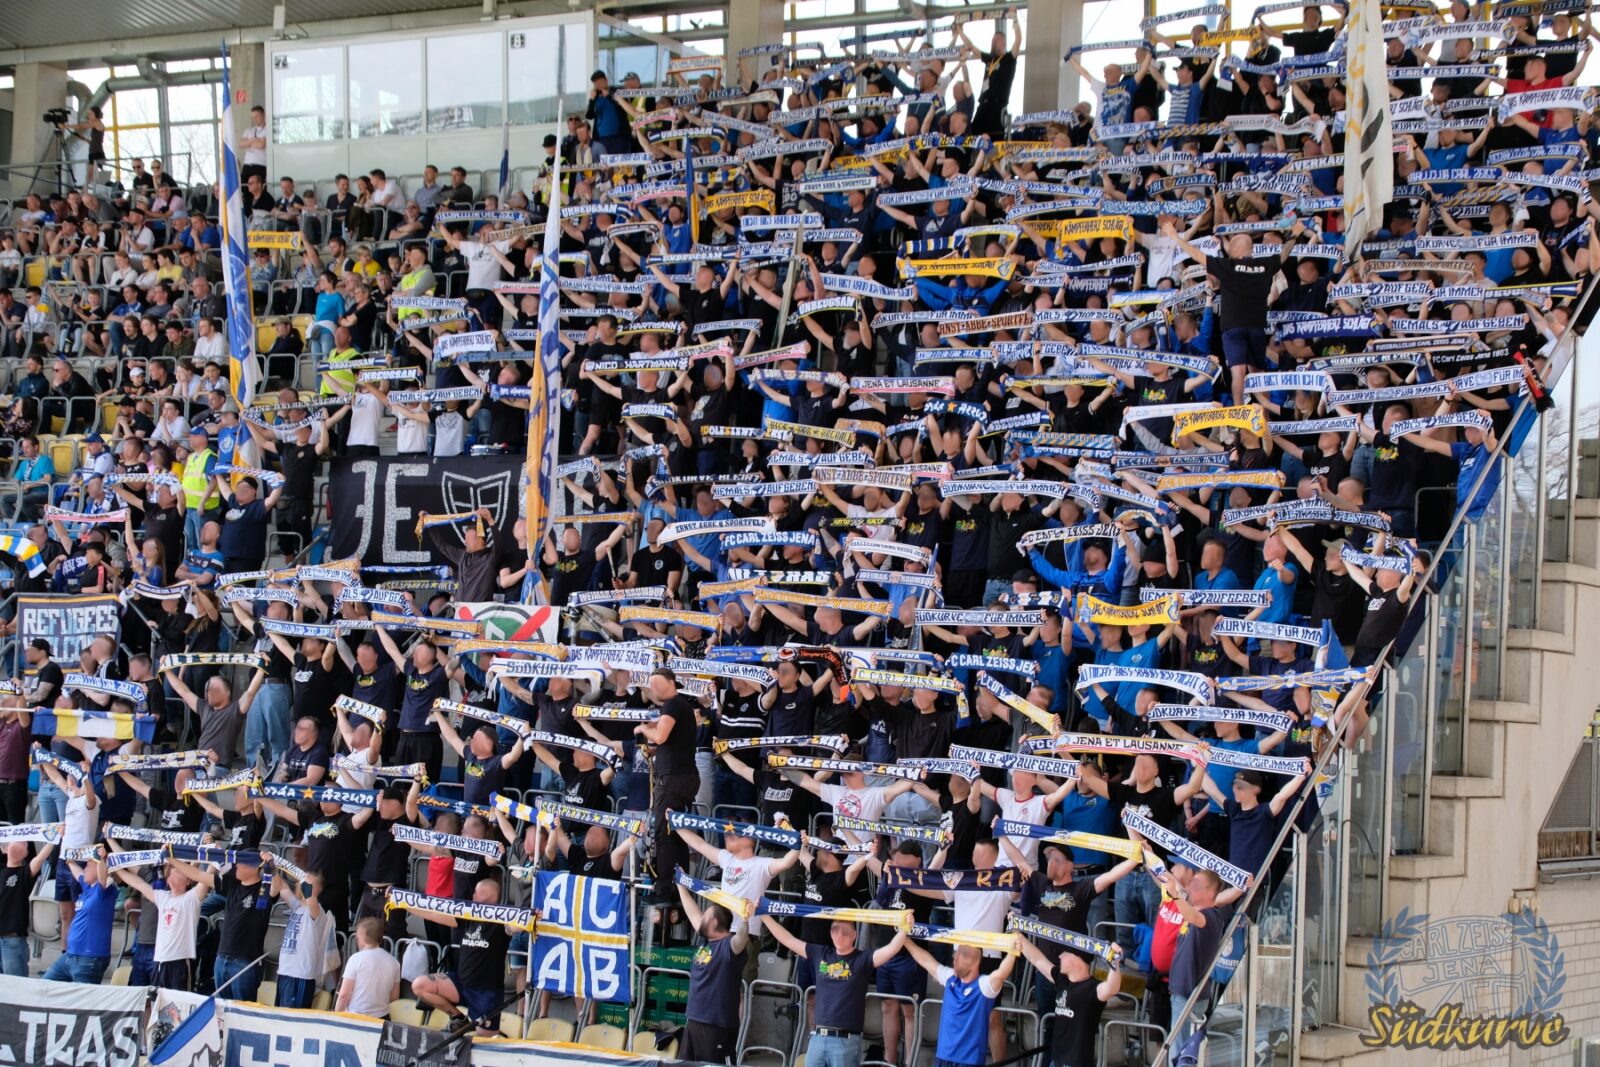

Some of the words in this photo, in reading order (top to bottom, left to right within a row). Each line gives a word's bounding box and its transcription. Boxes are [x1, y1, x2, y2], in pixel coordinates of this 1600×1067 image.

[1478, 237, 1495, 247] FÜR
[1496, 233, 1537, 247] IMMER
[595, 360, 617, 371] NICO
[624, 357, 678, 370] HARTMANN
[862, 379, 882, 389] JENA
[885, 379, 895, 388] ET
[898, 378, 940, 388] LAUSANNE
[702, 426, 754, 439] DOLESCENT
[840, 470, 864, 483] ABBE
[867, 471, 912, 488] SPORTFEL
[737, 532, 759, 546] CARL
[761, 530, 787, 544] ZEISS
[789, 531, 814, 546] JENA
[625, 587, 665, 602] NAUMBUR
[23, 605, 118, 635] REFUGEES
[984, 612, 1003, 624] FÜR
[1005, 612, 1045, 625] IMMER
[1277, 624, 1298, 637] FÜR
[506, 661, 579, 678] SÜDKURVE
[722, 664, 741, 676] FÜR
[960, 655, 985, 668] CARL
[987, 658, 1015, 672] ZEISS
[869, 671, 895, 684] CARL
[902, 674, 935, 688] ZEISS
[434, 697, 491, 720] DOLESCENT
[1223, 711, 1245, 722] FÜR
[1248, 712, 1289, 731] IMMER
[1029, 738, 1044, 751] FC
[1072, 736, 1103, 748] JENA
[1106, 737, 1120, 748] ET
[1123, 738, 1183, 753] LAUSANNE
[951, 746, 996, 765] NIEMALS
[1016, 758, 1079, 777] AUFGEBEN
[1270, 758, 1304, 774] IMMER
[321, 788, 375, 807] Azzuro
[671, 812, 718, 833] Horda
[740, 824, 798, 847] Azzuro
[1123, 810, 1168, 845] NIEMALS
[976, 868, 1017, 888] RA
[393, 889, 462, 916] POLIZIA
[471, 903, 533, 927] MERDA
